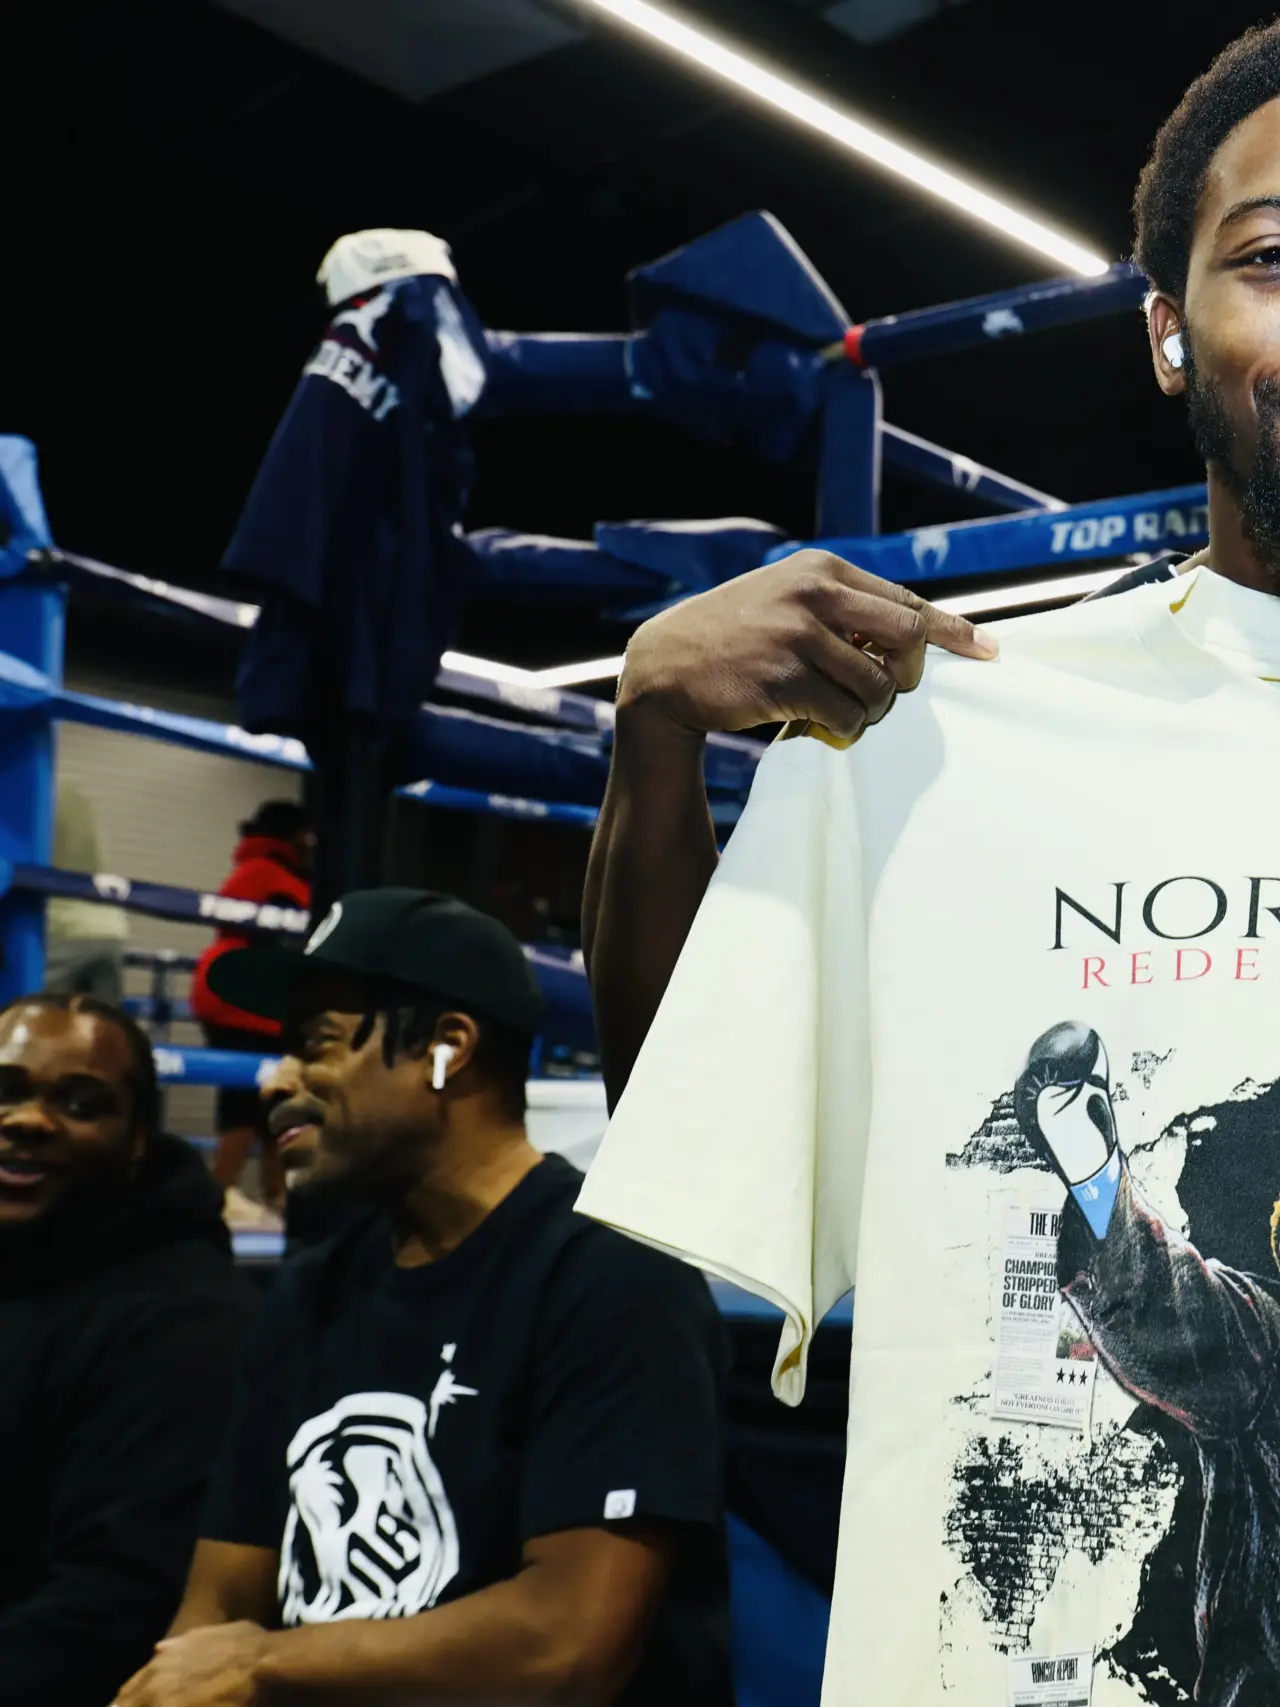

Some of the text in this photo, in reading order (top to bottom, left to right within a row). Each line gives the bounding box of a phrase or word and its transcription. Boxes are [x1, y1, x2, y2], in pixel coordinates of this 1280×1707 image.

[1051, 505, 1209, 553] TOP RAN
[1030, 1212, 1048, 1236] THE
[1003, 1275, 1056, 1294] STRIPPED
[1002, 1292, 1055, 1312] OF GLORY
